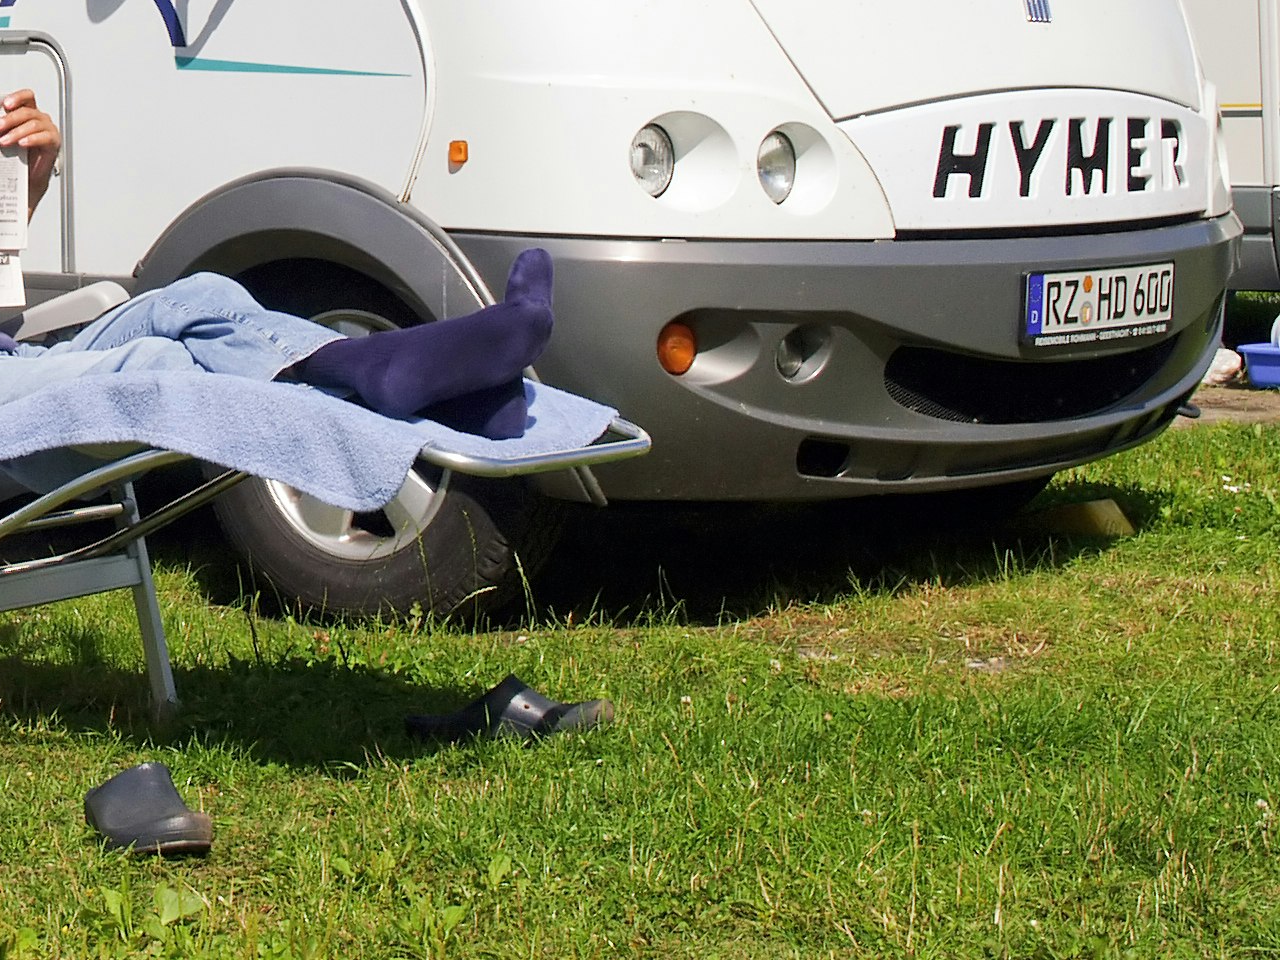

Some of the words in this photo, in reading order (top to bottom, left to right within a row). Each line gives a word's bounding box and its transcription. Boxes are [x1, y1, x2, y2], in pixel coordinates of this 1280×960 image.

[932, 117, 1186, 198] HYMER
[1030, 310, 1039, 324] D
[1045, 280, 1079, 326] RZ
[1097, 275, 1128, 321] HD
[1133, 269, 1171, 317] 600
